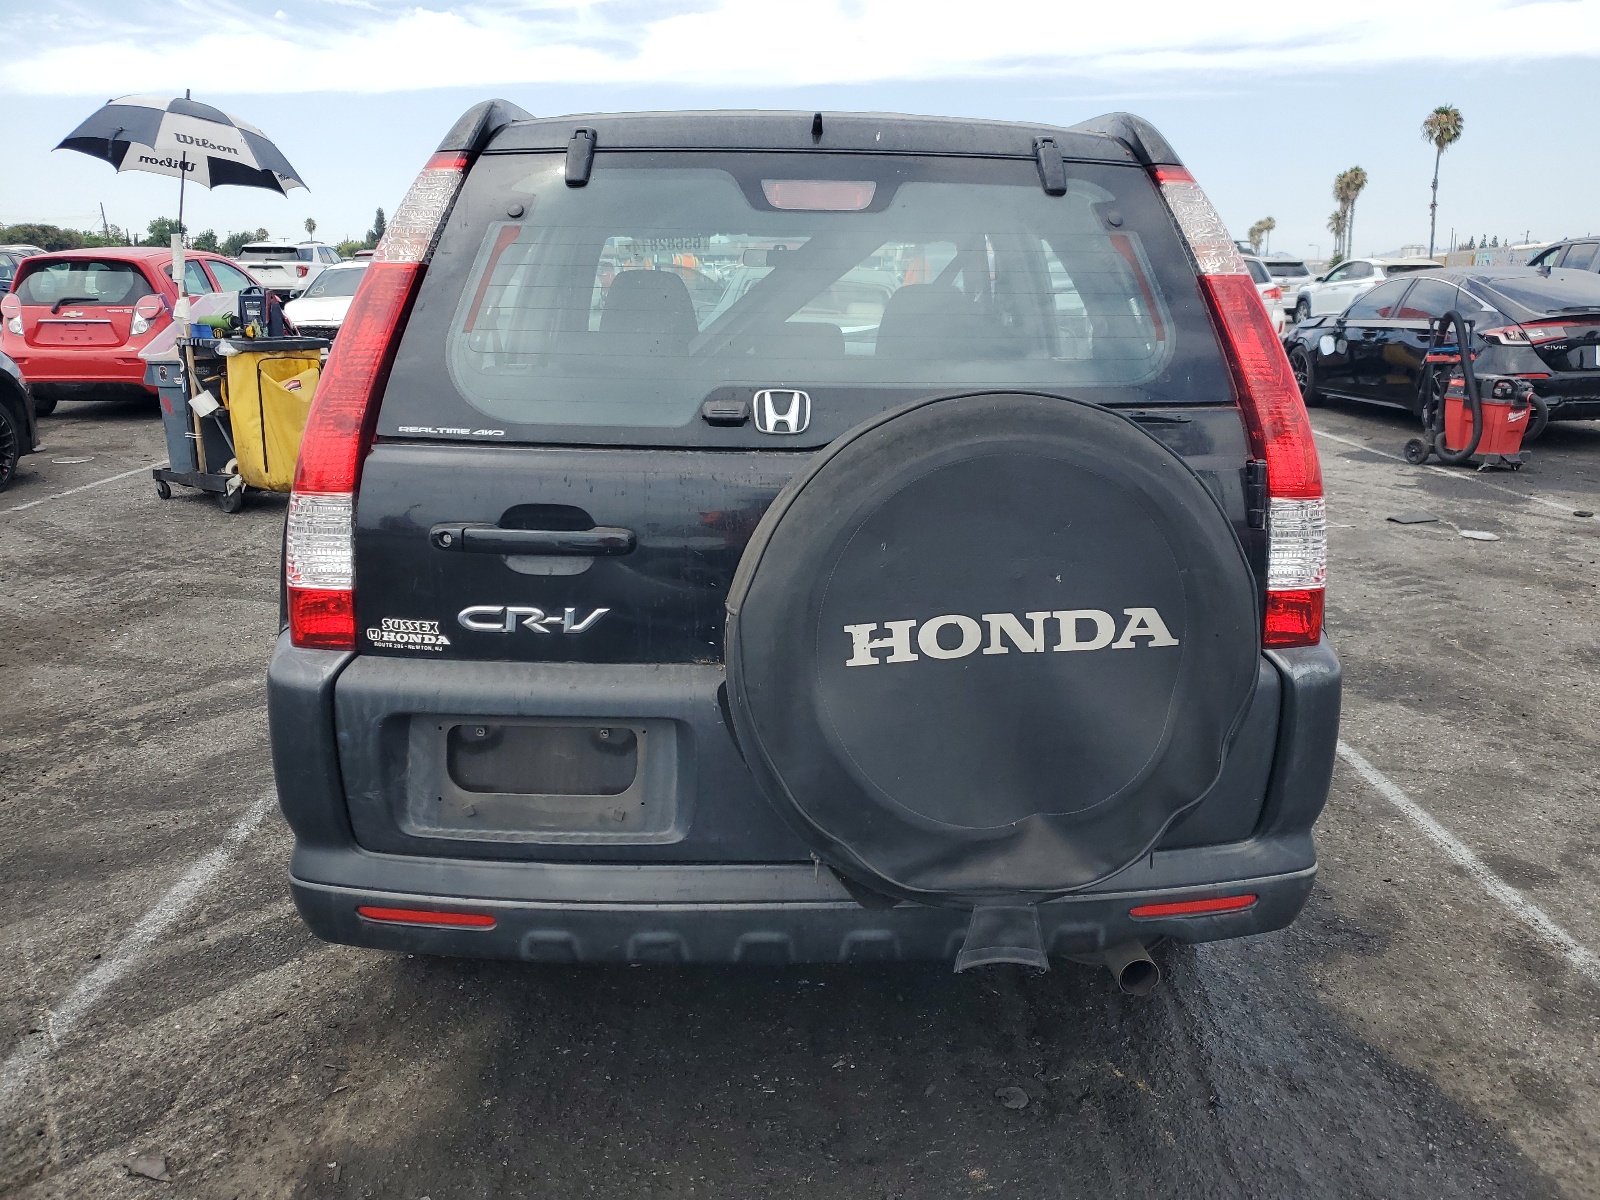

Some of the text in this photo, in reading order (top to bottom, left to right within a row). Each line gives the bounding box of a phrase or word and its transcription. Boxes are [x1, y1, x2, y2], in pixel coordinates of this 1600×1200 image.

[173, 132, 240, 155] Wilson
[398, 426, 471, 435] REALTIME
[381, 618, 440, 634] SUSSEX
[457, 605, 611, 634] CR-V
[382, 631, 451, 645] HONDA
[843, 607, 1180, 667] HONDA
